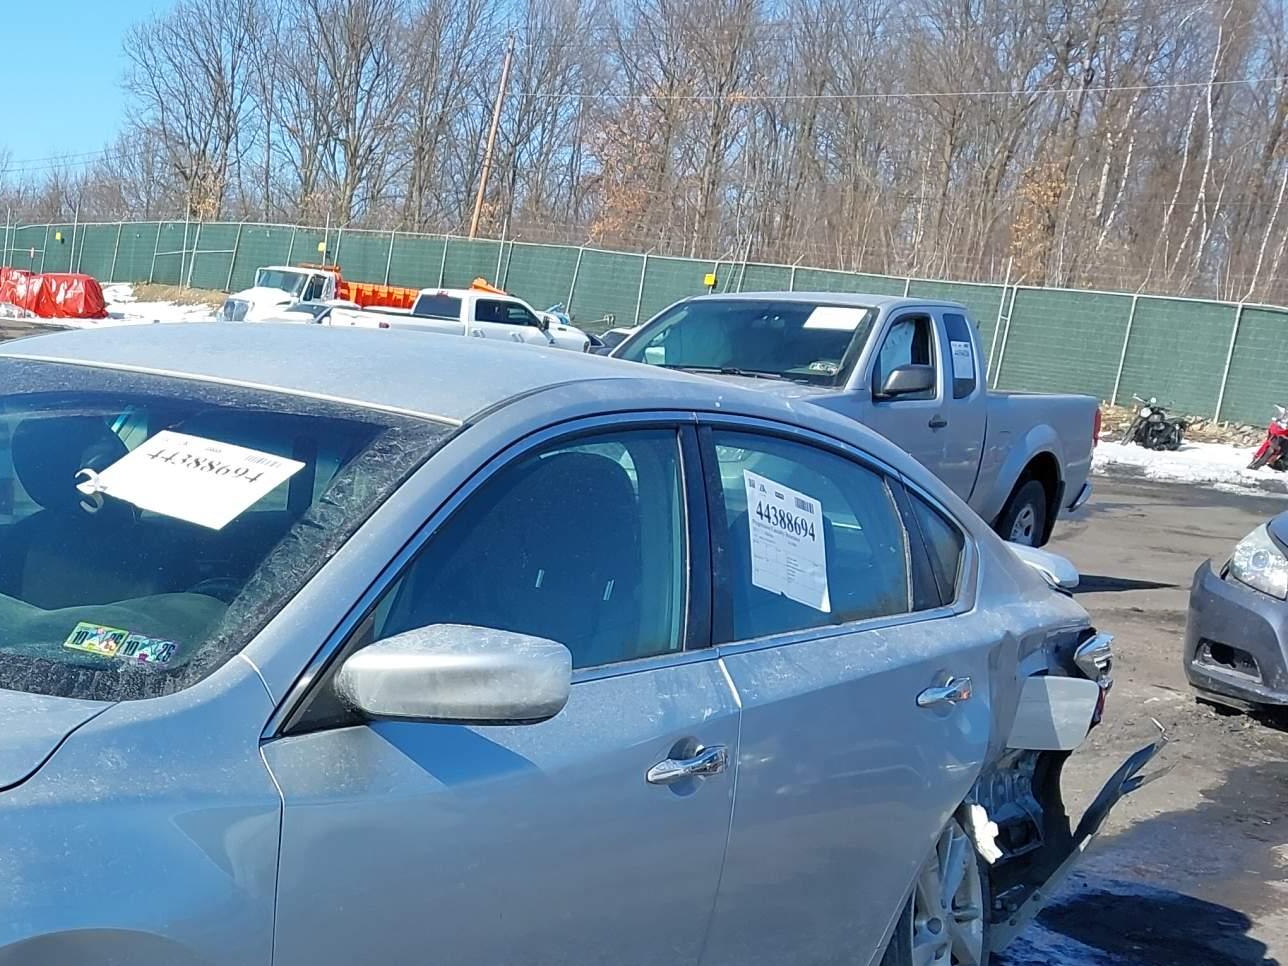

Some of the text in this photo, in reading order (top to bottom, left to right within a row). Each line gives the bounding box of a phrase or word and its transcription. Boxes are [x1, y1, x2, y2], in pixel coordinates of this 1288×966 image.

[147, 449, 265, 483] 44388694
[756, 500, 816, 541] 44388694
[123, 640, 176, 662] 10 26
